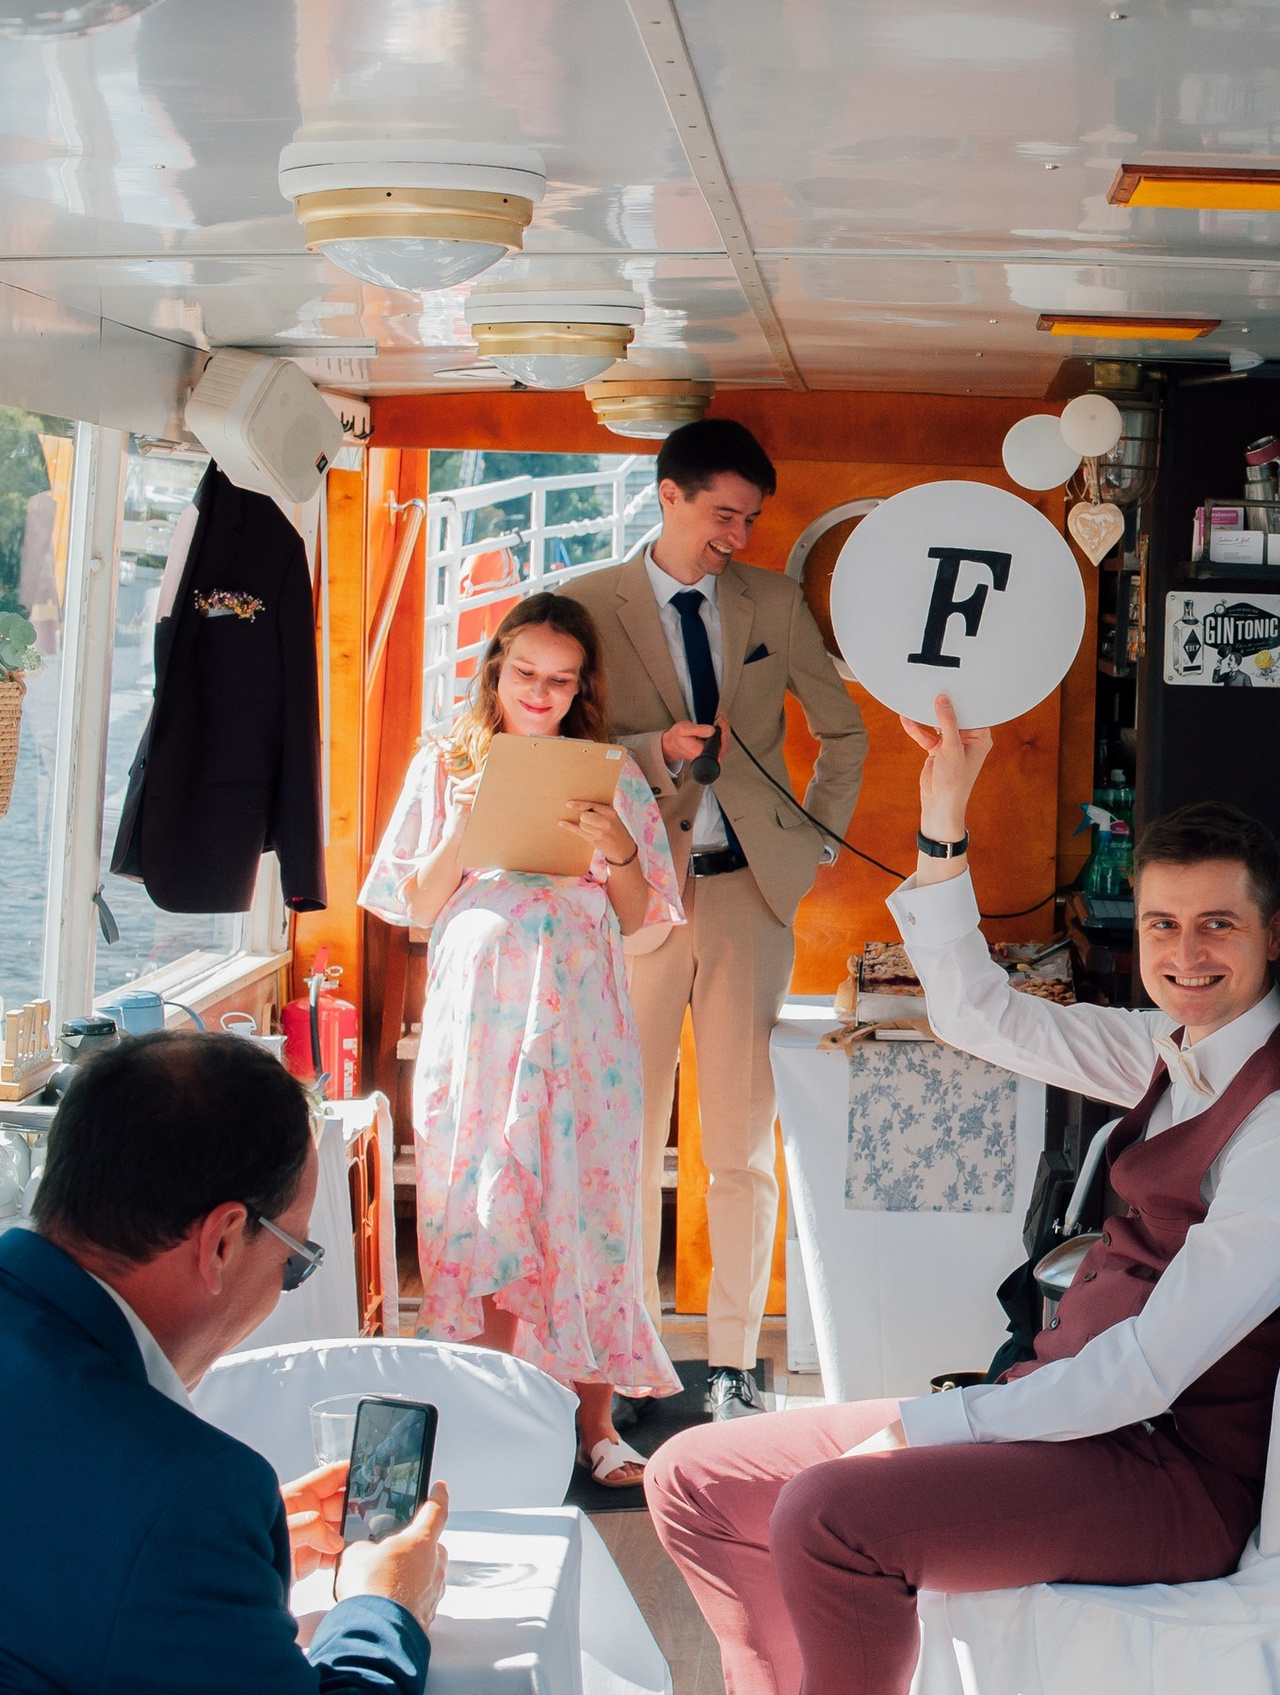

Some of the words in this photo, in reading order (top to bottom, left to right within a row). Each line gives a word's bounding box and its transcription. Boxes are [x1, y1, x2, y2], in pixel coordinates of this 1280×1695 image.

[907, 547, 1013, 669] F
[1205, 616, 1234, 645] GIN
[1236, 617, 1279, 641] TONIC
